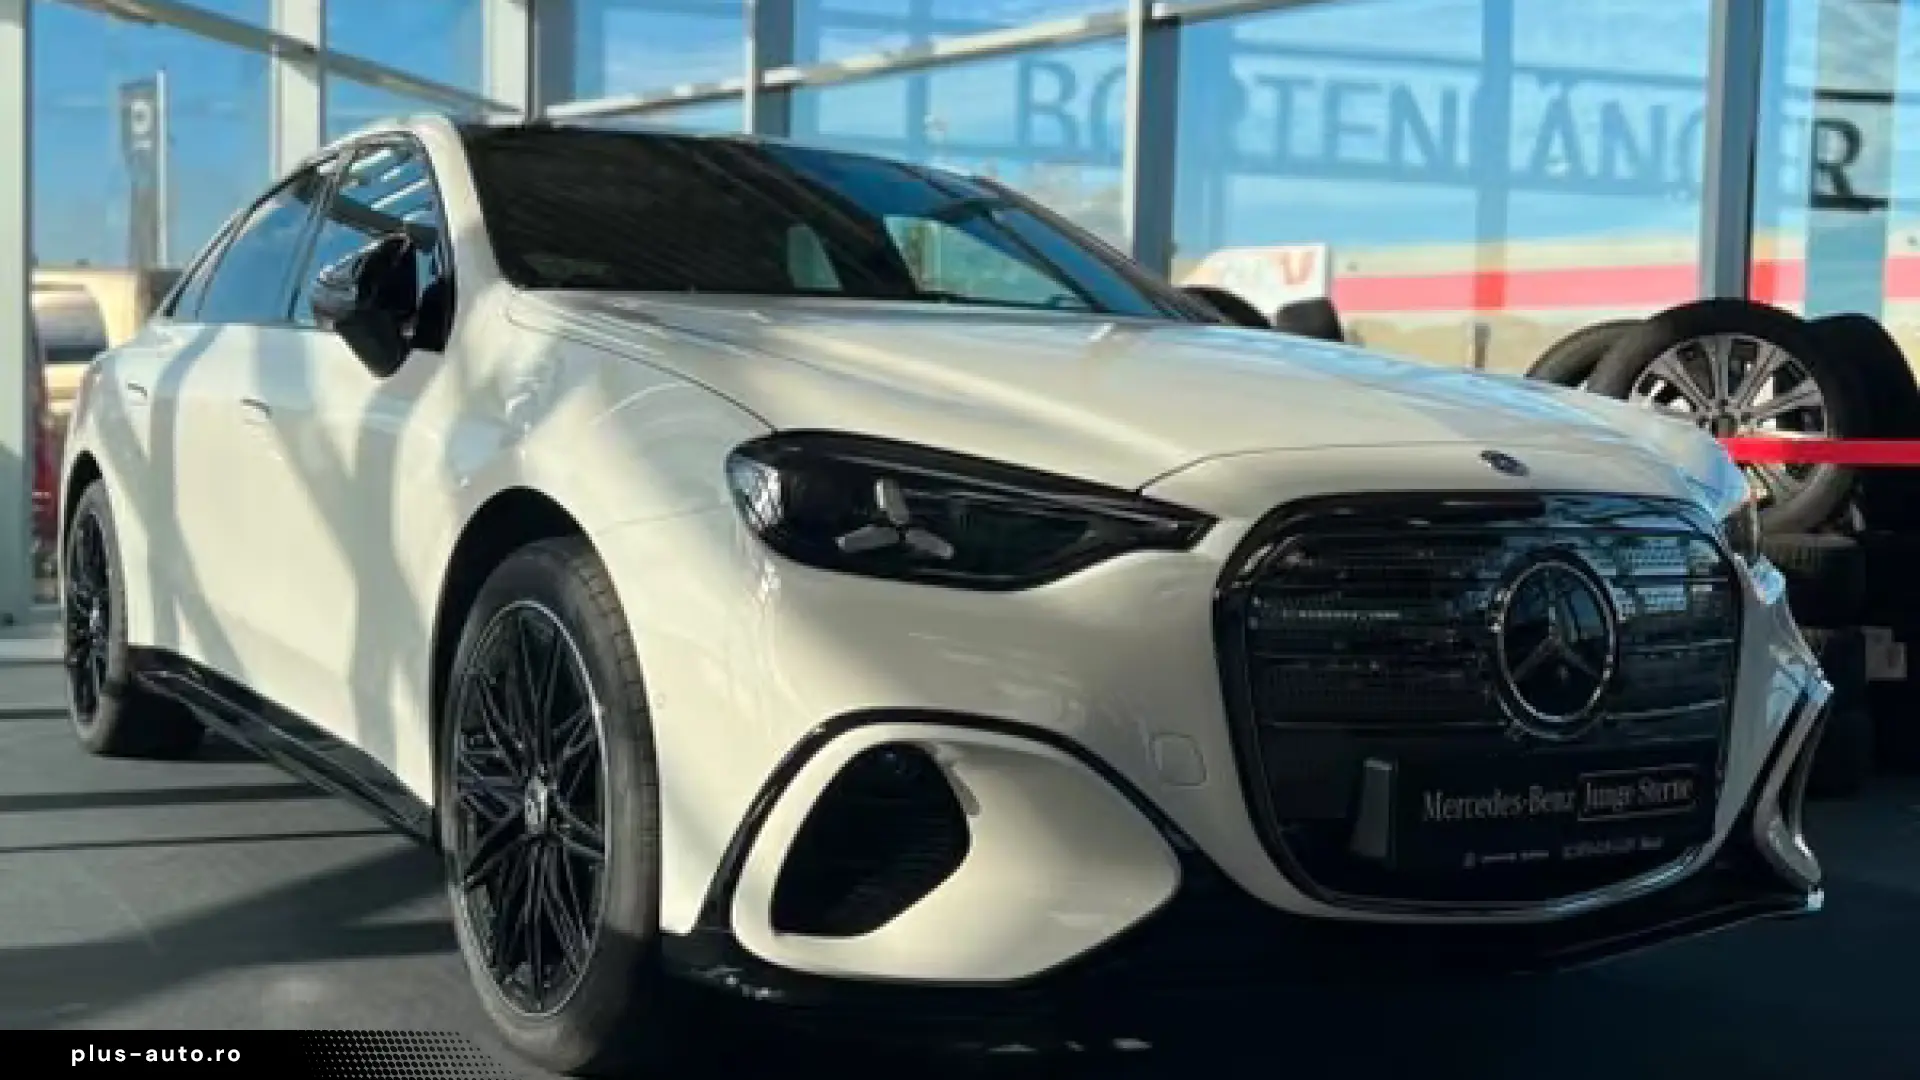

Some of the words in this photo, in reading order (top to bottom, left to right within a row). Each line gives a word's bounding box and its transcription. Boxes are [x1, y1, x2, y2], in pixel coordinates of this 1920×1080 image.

[1422, 783, 1576, 822] Mercedes-Benz
[1585, 781, 1632, 813] Junge
[1637, 776, 1696, 803] Sterne
